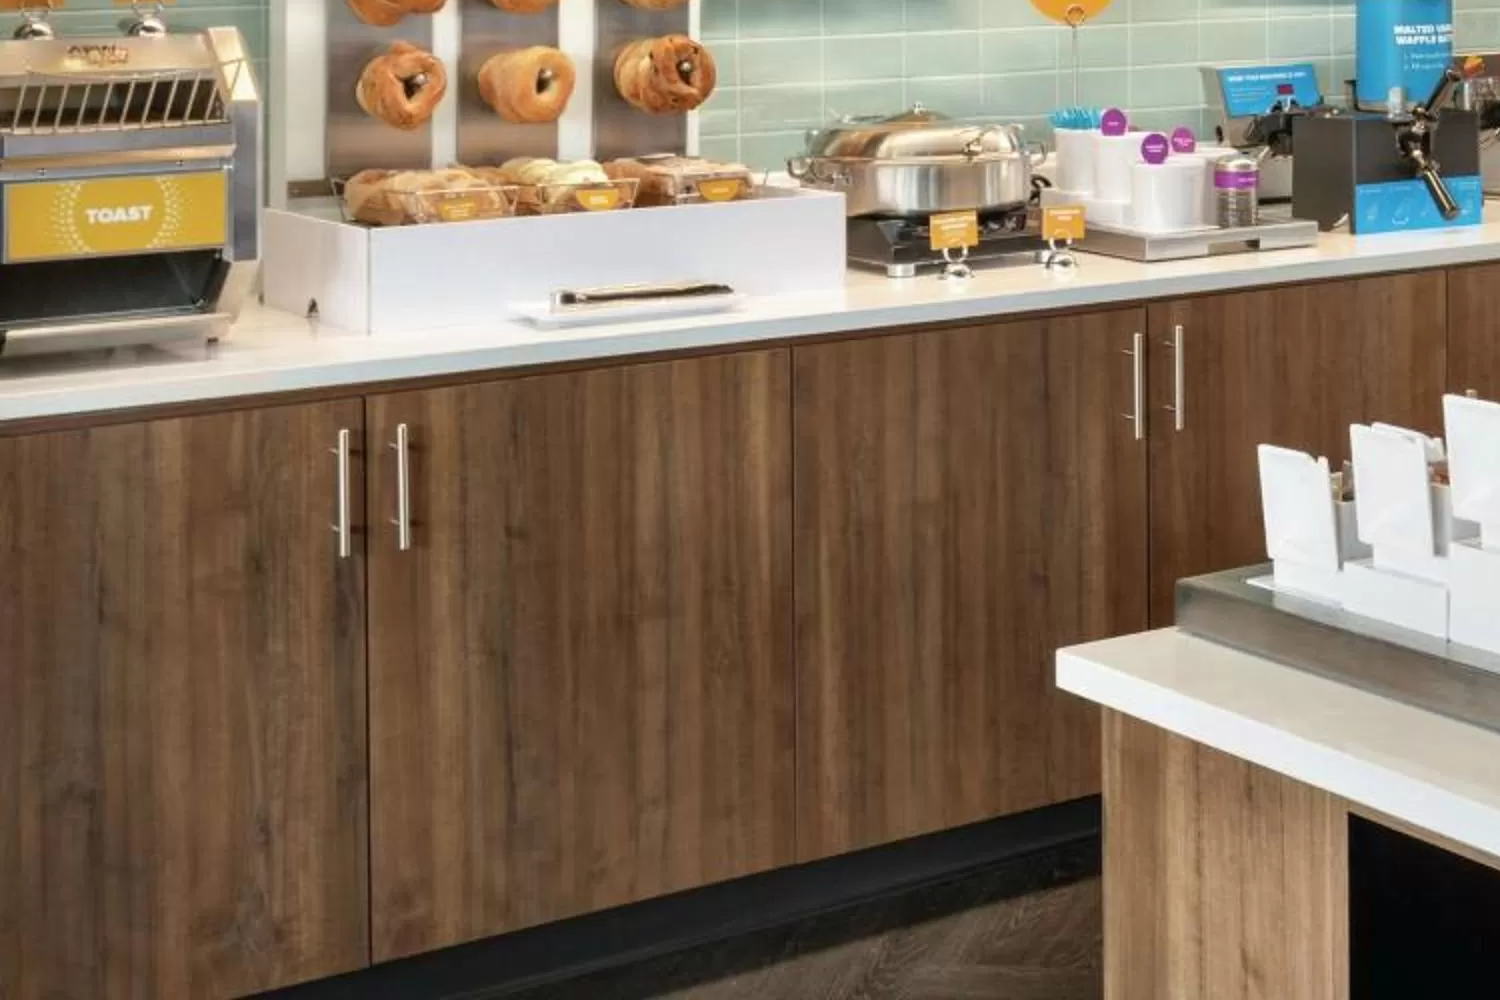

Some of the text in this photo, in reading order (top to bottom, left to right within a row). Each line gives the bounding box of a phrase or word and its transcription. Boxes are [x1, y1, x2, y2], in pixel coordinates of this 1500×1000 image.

[1393, 25, 1435, 35] MALTED
[1395, 35, 1437, 45] WAFFLE
[86, 205, 152, 224] TOAST
